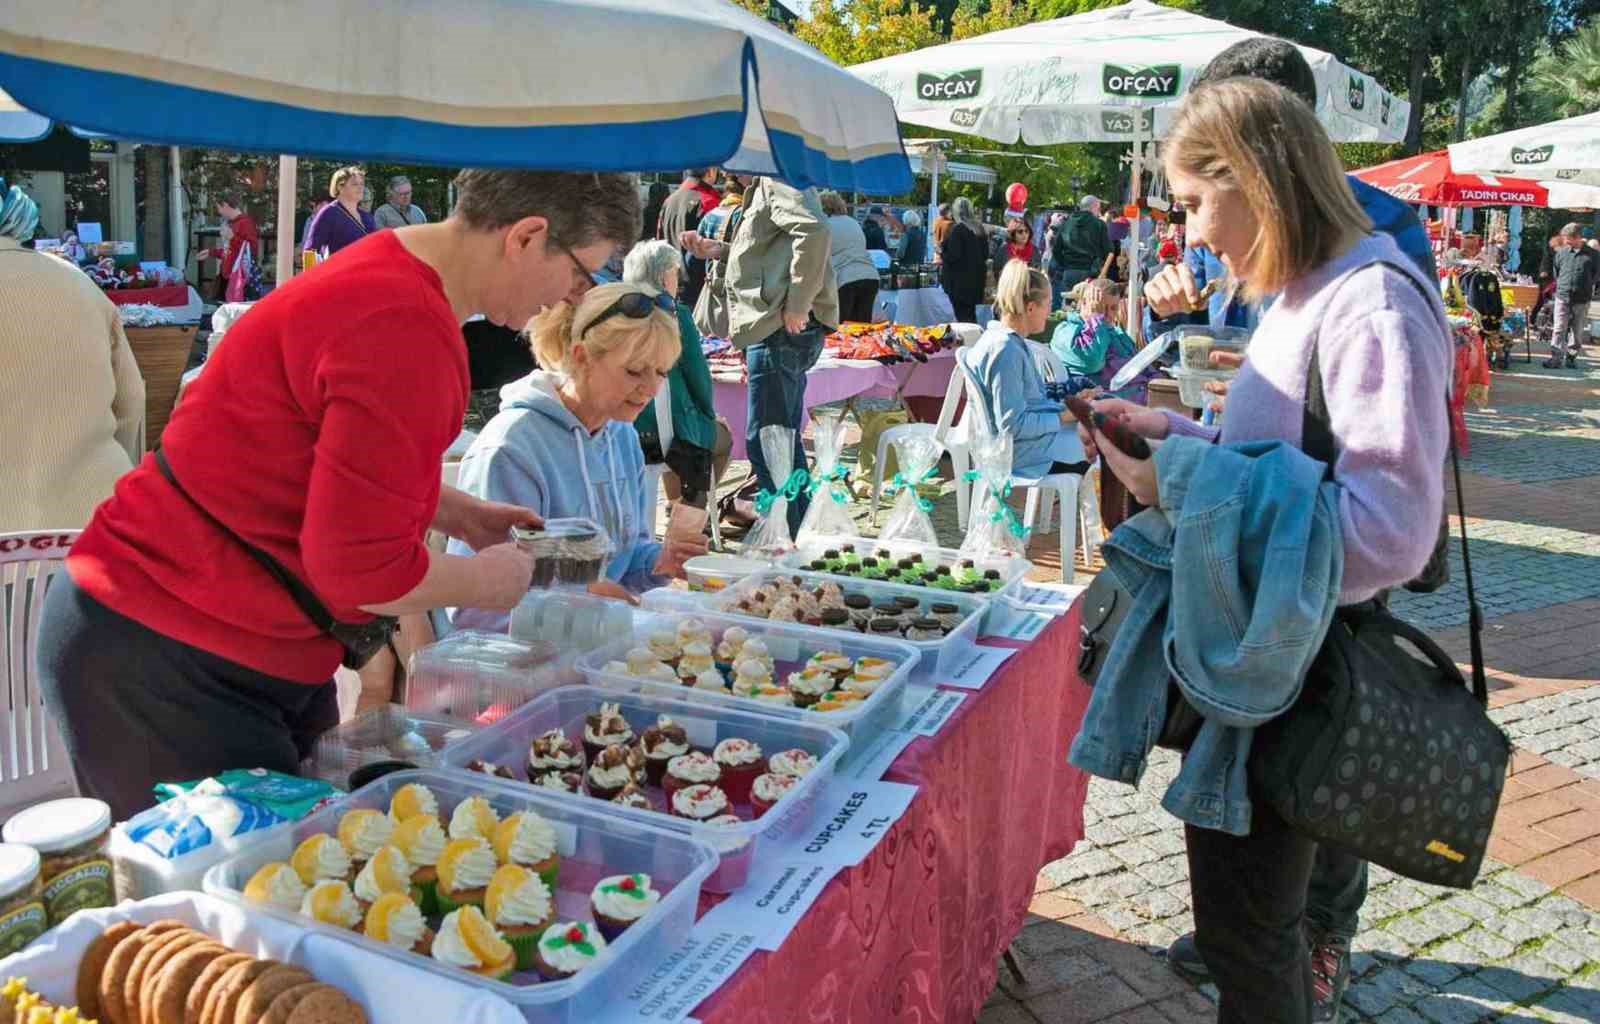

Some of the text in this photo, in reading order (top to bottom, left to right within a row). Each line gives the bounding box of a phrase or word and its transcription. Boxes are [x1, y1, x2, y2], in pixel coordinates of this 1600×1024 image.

[921, 80, 977, 98] OFÇAY
[1108, 76, 1173, 95] OFÇAY
[804, 791, 868, 853] CUPCAKES
[866, 816, 890, 830] TL
[755, 866, 798, 908] Caramel
[777, 866, 824, 914] Cupcakes
[709, 935, 755, 975] BUTTER
